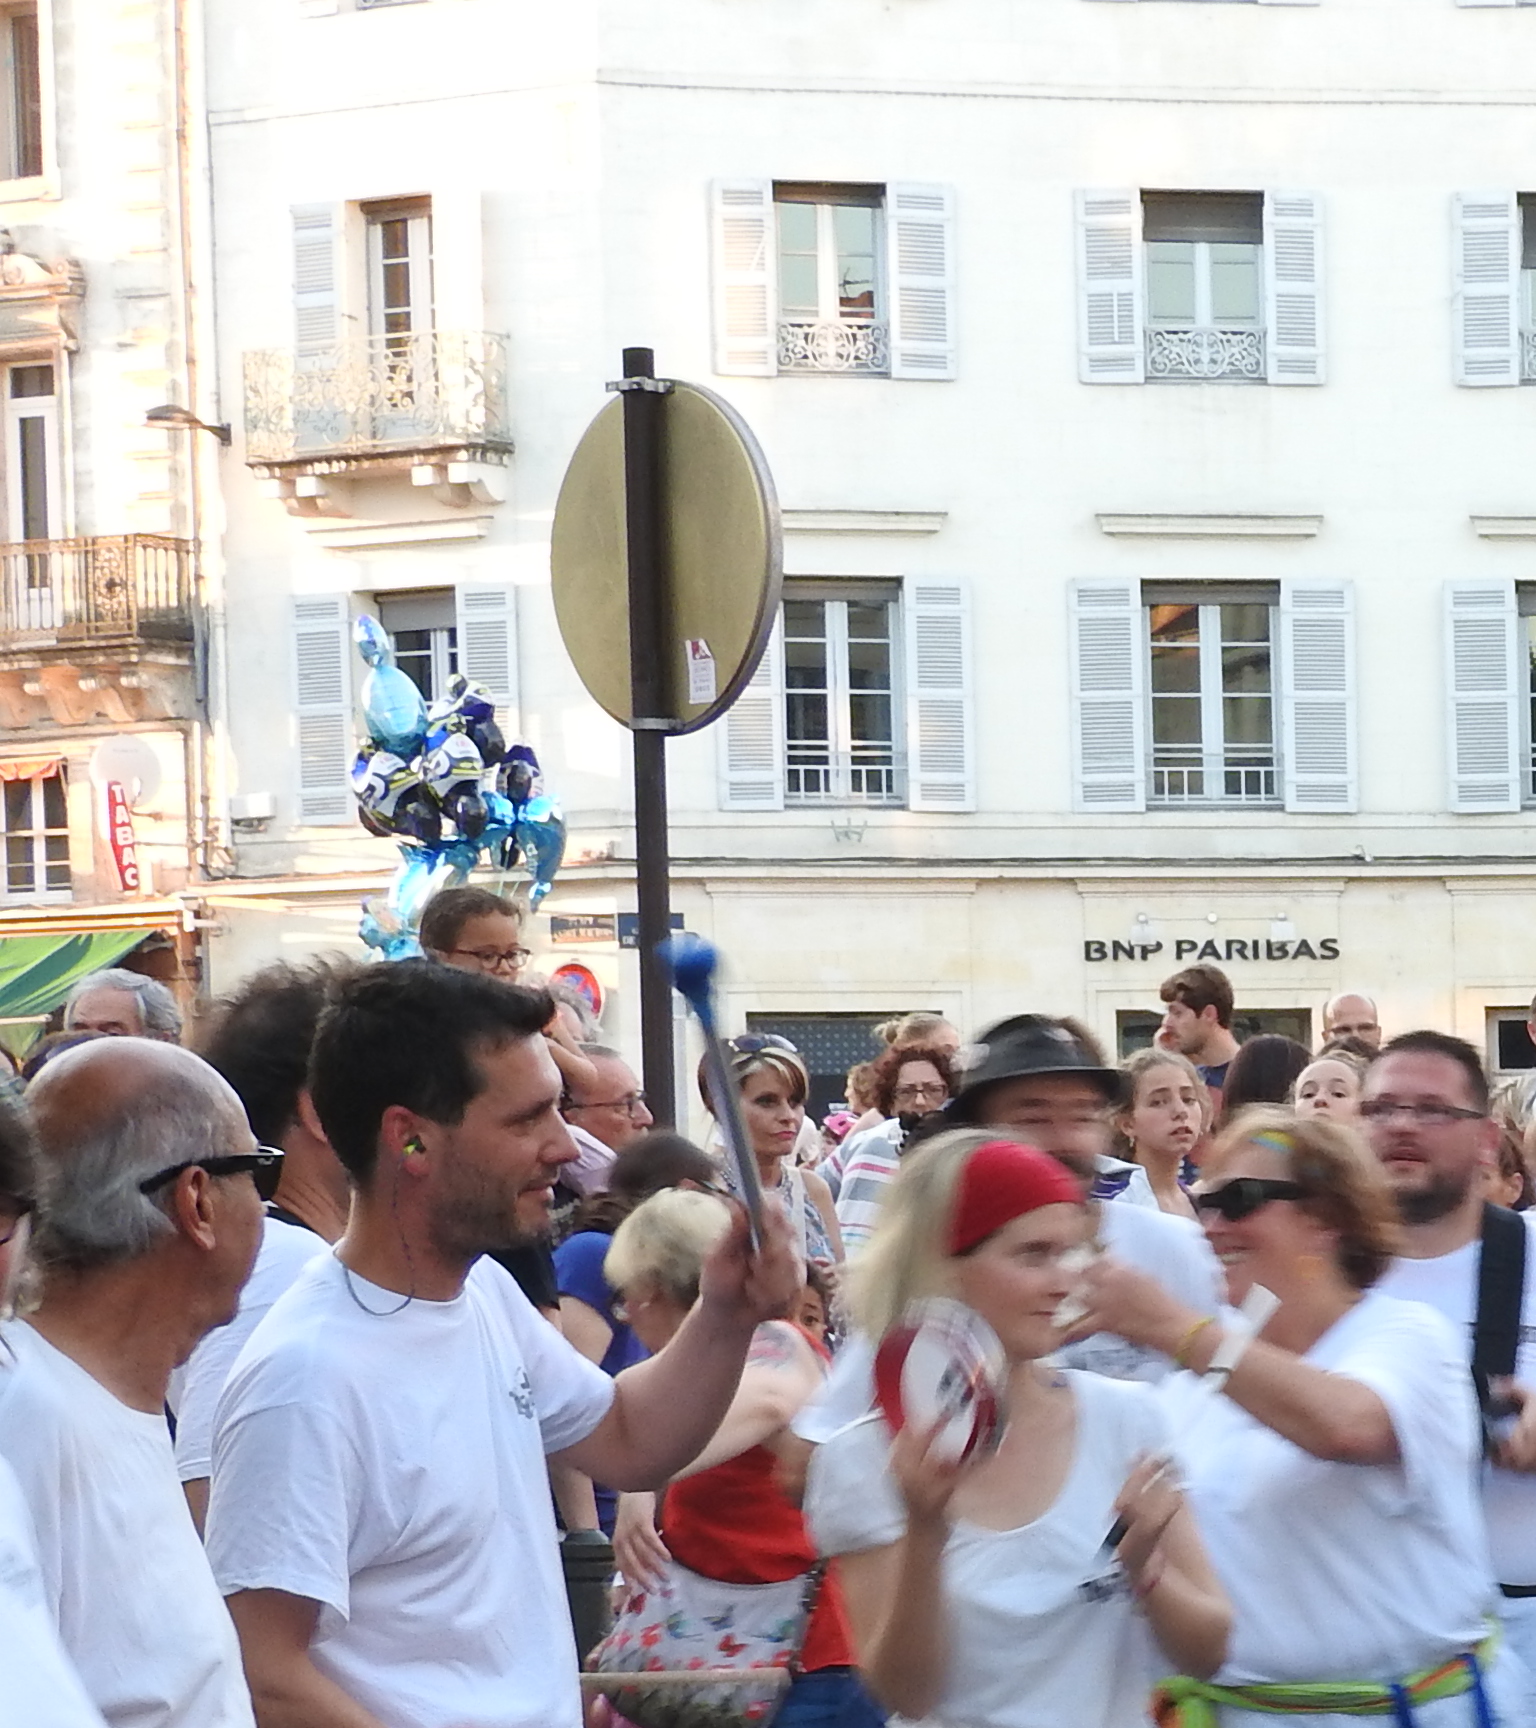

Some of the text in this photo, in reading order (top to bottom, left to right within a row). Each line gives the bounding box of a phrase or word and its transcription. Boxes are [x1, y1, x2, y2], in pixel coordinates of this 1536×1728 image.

[111, 785, 138, 886] TABAC
[1084, 938, 1340, 961] BNP PARIBAS
